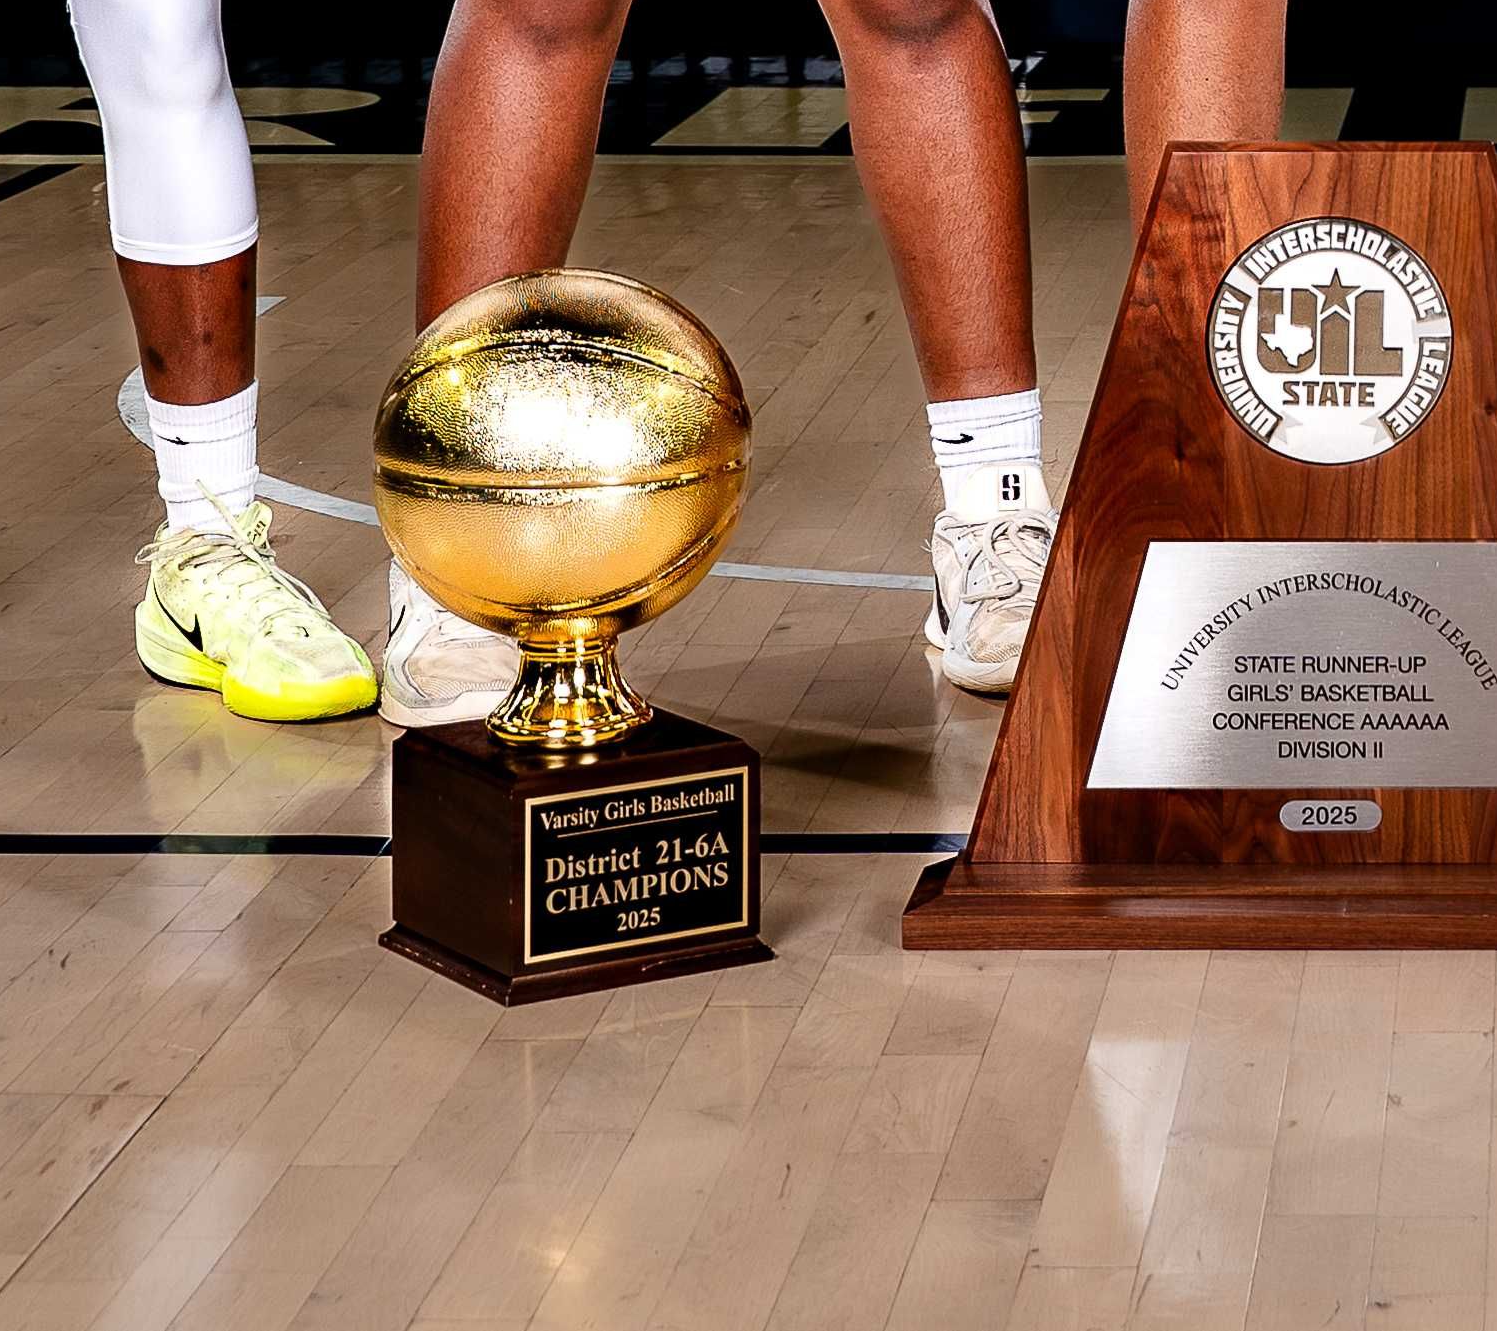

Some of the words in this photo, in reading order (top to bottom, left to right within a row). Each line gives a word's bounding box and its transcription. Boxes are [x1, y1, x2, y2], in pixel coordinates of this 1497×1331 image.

[1244, 224, 1444, 319] INTERSCHOLASTIC
[1214, 290, 1278, 437] UNIVERSITY
[1282, 381, 1375, 407] STATE
[1385, 341, 1447, 435] LEAGUE
[1160, 593, 1256, 692] UNIVERSITY
[1257, 572, 1440, 625] INTERSCHOLASTIC
[1234, 656, 1295, 674] STATE
[1302, 656, 1427, 674] RUNNER-UP
[1301, 684, 1434, 702] BASKETBALL
[1212, 712, 1354, 731] CONFERENCE
[1360, 712, 1449, 731] AAAAAA
[1278, 741, 1367, 759] DIVISION
[1374, 741, 1383, 759] II
[540, 807, 599, 830] Varsity
[604, 798, 645, 820] Girls
[651, 784, 735, 813] Basketball
[1301, 806, 1357, 826] 2025
[545, 846, 641, 883] District
[656, 832, 729, 865] 21-6A
[546, 862, 729, 914] CHAMPIONS
[617, 907, 661, 931] 2025
